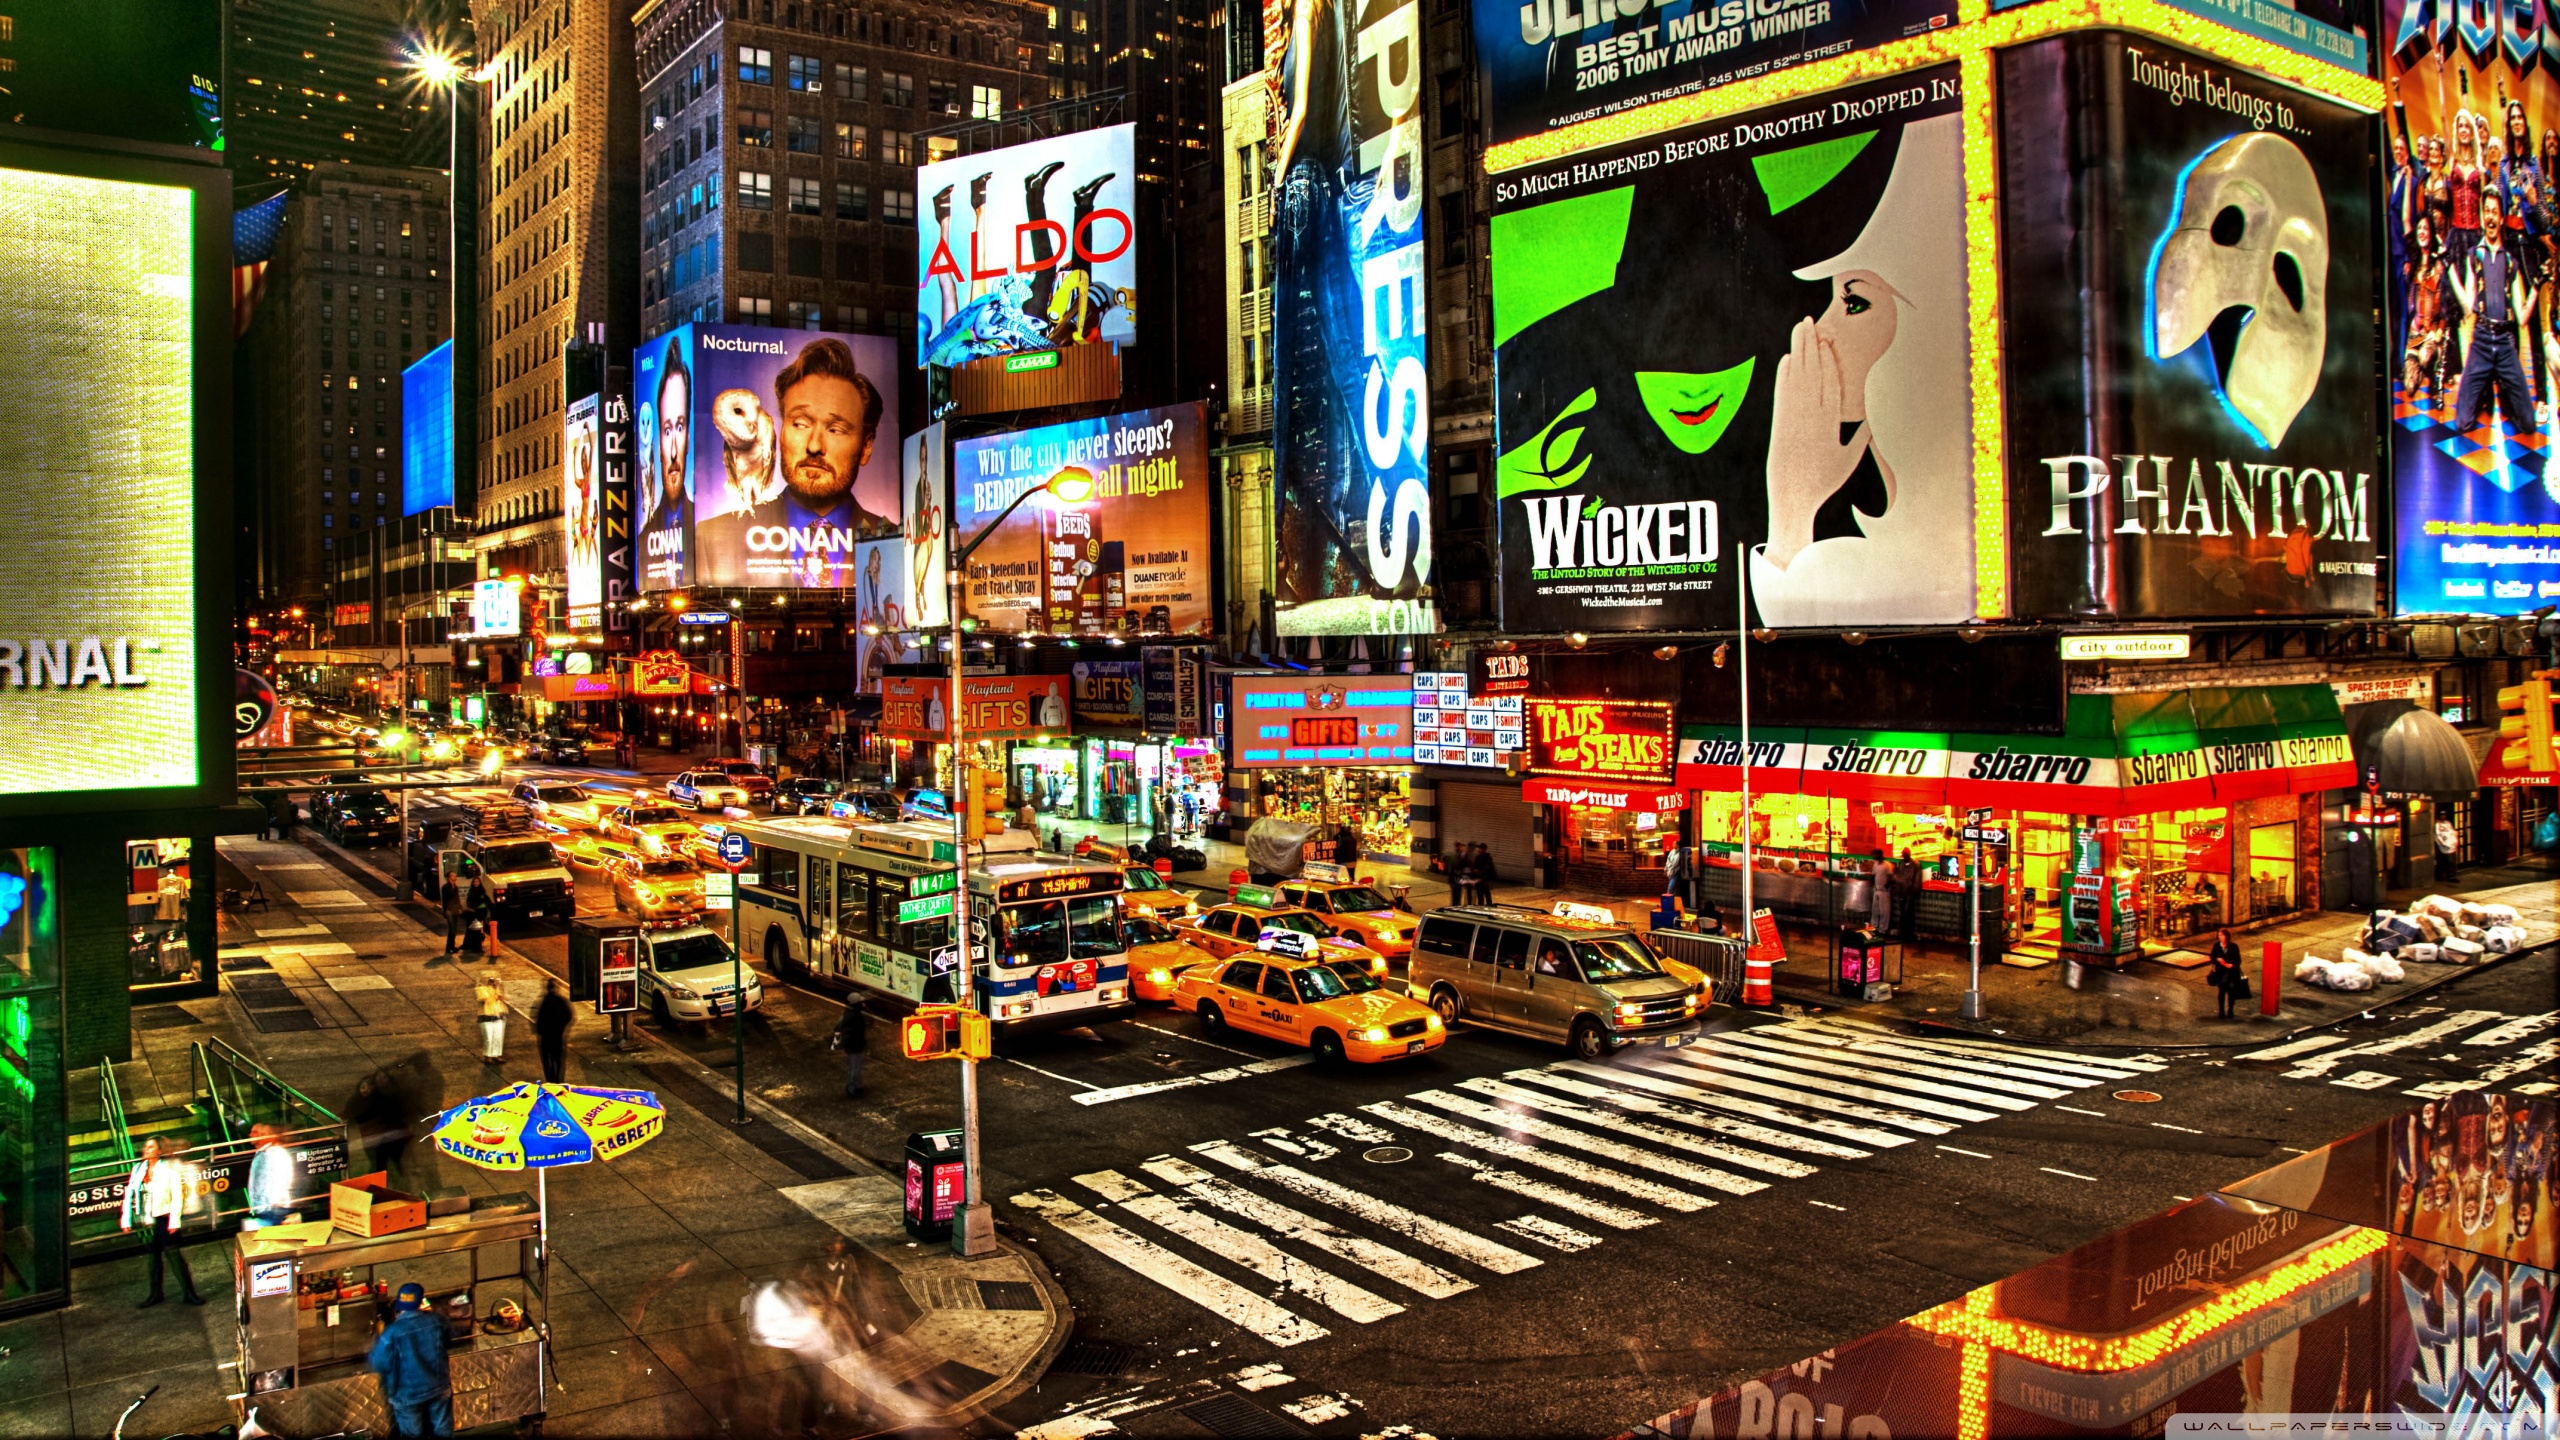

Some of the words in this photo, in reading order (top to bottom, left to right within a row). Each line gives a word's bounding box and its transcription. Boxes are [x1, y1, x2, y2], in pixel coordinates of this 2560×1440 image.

[1576, 24, 1660, 69] BEST
[1576, 61, 1620, 92] 2006
[1625, 48, 1670, 78] TONY
[1750, 2, 1832, 43] WINNER
[1558, 107, 1601, 126] AUGUST
[1605, 93, 1648, 116] WILSON
[1650, 80, 1706, 103] THEATRE,
[1708, 72, 1733, 88] 245
[1736, 61, 1771, 81] WEST
[1803, 39, 1854, 62] STREET
[2127, 46, 2202, 107] Tonight
[2204, 69, 2273, 127] belongs
[918, 207, 1133, 289] ALDO
[1355, 0, 1430, 589] PRESS
[702, 334, 789, 356] Nocturnal.
[1010, 353, 1053, 371] LAMAR
[977, 449, 1006, 477] Why
[1010, 443, 1033, 472] the
[1037, 440, 1062, 468] city
[1066, 432, 1110, 465] never
[1114, 418, 1174, 457] sleeps?
[1098, 463, 1122, 499] all
[1127, 455, 1184, 498] night.
[2040, 453, 2372, 543] PHANTOM
[605, 400, 630, 631] BRAZZERS
[905, 505, 942, 548] ALDO
[647, 527, 683, 557] CONAN
[745, 525, 854, 553] CONAN
[1049, 541, 1075, 560] Bedbug
[1131, 553, 1145, 566] Now
[1147, 550, 1179, 565] Available
[1180, 549, 1188, 563] At
[970, 564, 988, 580] Early
[990, 561, 1025, 578] Detection
[1027, 560, 1039, 576] Kit
[1049, 559, 1064, 574] Early
[2324, 561, 2353, 577] MAJESTIC
[1049, 573, 1078, 587] Detection
[1133, 572, 1159, 583] DUANE
[973, 582, 987, 596] and
[989, 579, 1013, 595] Travel
[1014, 578, 1036, 596] Spray
[1050, 588, 1073, 603] System
[1554, 583, 1594, 595] GERSHWIN
[1594, 583, 1631, 595] THEATRE,
[1631, 582, 1645, 594] 222
[1646, 581, 1668, 593] WEST
[1667, 580, 1683, 592] 51st
[1683, 580, 1713, 592] STREET
[1130, 594, 1140, 603] and
[1140, 593, 1154, 603] other
[1155, 592, 1170, 603] metro
[1170, 591, 1192, 602] retailers
[1581, 595, 1663, 608] WickedtheMusical.com
[569, 616, 601, 629] BRAZZERS
[682, 613, 697, 622] Van
[698, 613, 727, 623] Wagner
[2079, 639, 2110, 656] city
[2115, 638, 2175, 655] outdoor
[1093, 662, 1122, 677] Playland
[1151, 671, 1174, 681] VIDEOS
[1486, 655, 1529, 679] TADS
[964, 681, 1014, 699] Playland
[1085, 676, 1134, 702] GIFTS
[1417, 675, 1433, 687] CAPS
[1440, 676, 1464, 688] T-SHIRTS
[2347, 682, 2375, 694] SPACE
[2375, 680, 2392, 692] FOR
[2393, 678, 2413, 690] RENT
[1244, 692, 1306, 709] PHANTOM
[1443, 694, 1460, 706] CAPS
[1499, 696, 1517, 708] CAPS
[884, 701, 923, 728] GIFTS
[1418, 712, 1434, 724] CAPS
[1440, 712, 1465, 725] T-SHIRTS
[1471, 714, 1488, 726] CAPS
[1495, 715, 1521, 727] T-SHIRTS
[1536, 704, 1605, 743] TAD'S
[1294, 719, 1356, 745] GIFTS
[1414, 730, 1439, 742] T-SHIRTS
[1444, 731, 1461, 743] CAPS
[1467, 732, 1493, 745] T-SHIRTS
[1499, 733, 1518, 745] CAPS
[1418, 748, 1435, 760] CAPS
[1440, 749, 1466, 761] T-SHIRTS
[1471, 751, 1489, 763] CAPS
[1578, 733, 1664, 770] STEAKS
[1692, 733, 1786, 767] sbarro
[1822, 738, 1928, 776] sbarro
[2214, 737, 2276, 775] sbarro
[2288, 731, 2345, 766] sbarro
[1205, 754, 1217, 766] 10
[1968, 746, 2092, 785] sbarro
[2131, 748, 2198, 786] sbarro
[2520, 776, 2551, 785] STEAKS
[1545, 788, 1571, 803] TAD'S
[1588, 792, 1628, 808] STEAKS
[1655, 792, 1684, 811] TAD'S
[2386, 791, 2404, 800] 701
[2118, 820, 2136, 831] ATM
[2191, 823, 2223, 839] sbarro
[1986, 831, 2001, 840] WAY
[727, 856, 749, 868] STANDING
[1706, 848, 1730, 860] sbarro
[920, 876, 929, 893] W
[931, 873, 945, 891] 47
[946, 871, 954, 881] ST
[1017, 882, 1030, 897] M7
[2073, 876, 2100, 886] MORE
[900, 900, 927, 915] FATHER
[928, 897, 951, 911] DUFFY
[1571, 911, 1602, 923] ALDO
[939, 952, 955, 966] ONE
[1271, 1008, 1293, 1025] TAXI
[596, 1115, 662, 1154] SABRETT
[307, 1147, 333, 1159] Uptown
[307, 1152, 334, 1163] Queens
[439, 1137, 519, 1165] SABRETT
[307, 1158, 335, 1169] elevator
[69, 1190, 88, 1205] 49
[92, 1186, 110, 1202] St
[255, 1262, 290, 1281] SABRETT
